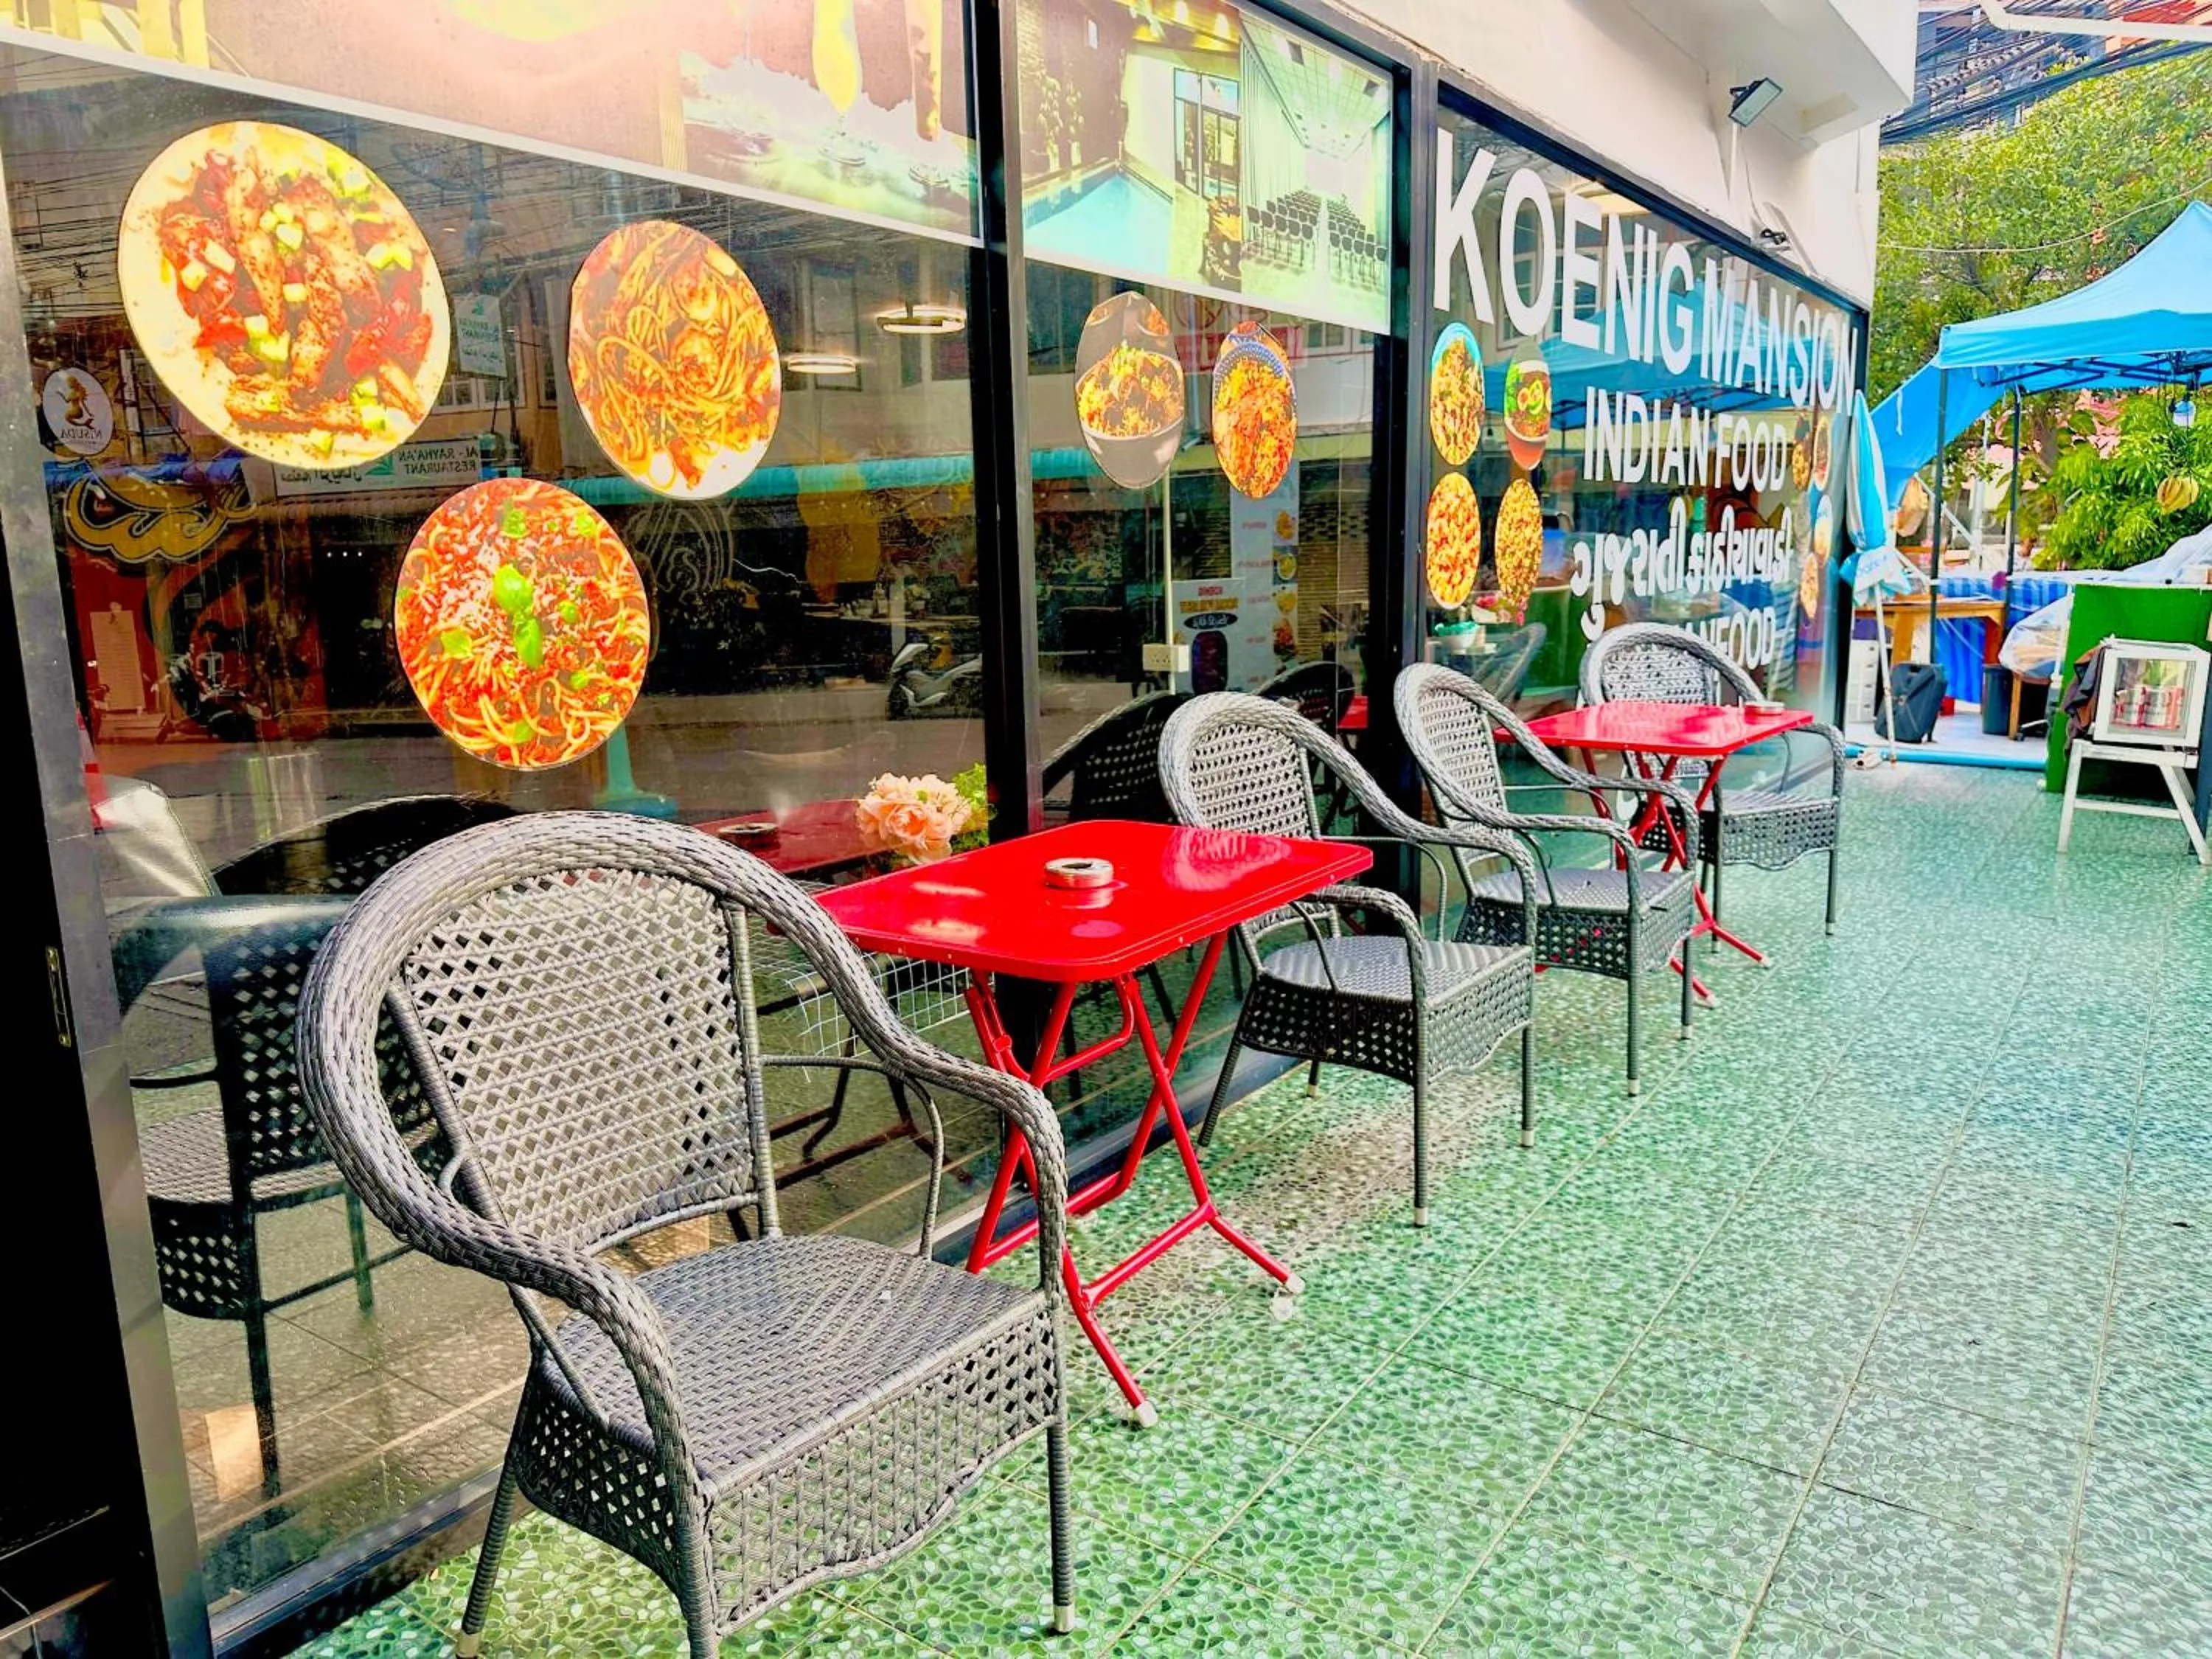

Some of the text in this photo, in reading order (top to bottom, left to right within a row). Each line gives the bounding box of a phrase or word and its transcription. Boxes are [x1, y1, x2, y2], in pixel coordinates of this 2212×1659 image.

[1433, 126, 1859, 416] KOENIG MANSION
[1583, 386, 1787, 492] INDIAN FOOD
[1570, 496, 1686, 641] ગુજરાતી
[1716, 606, 1776, 670] FOOD
